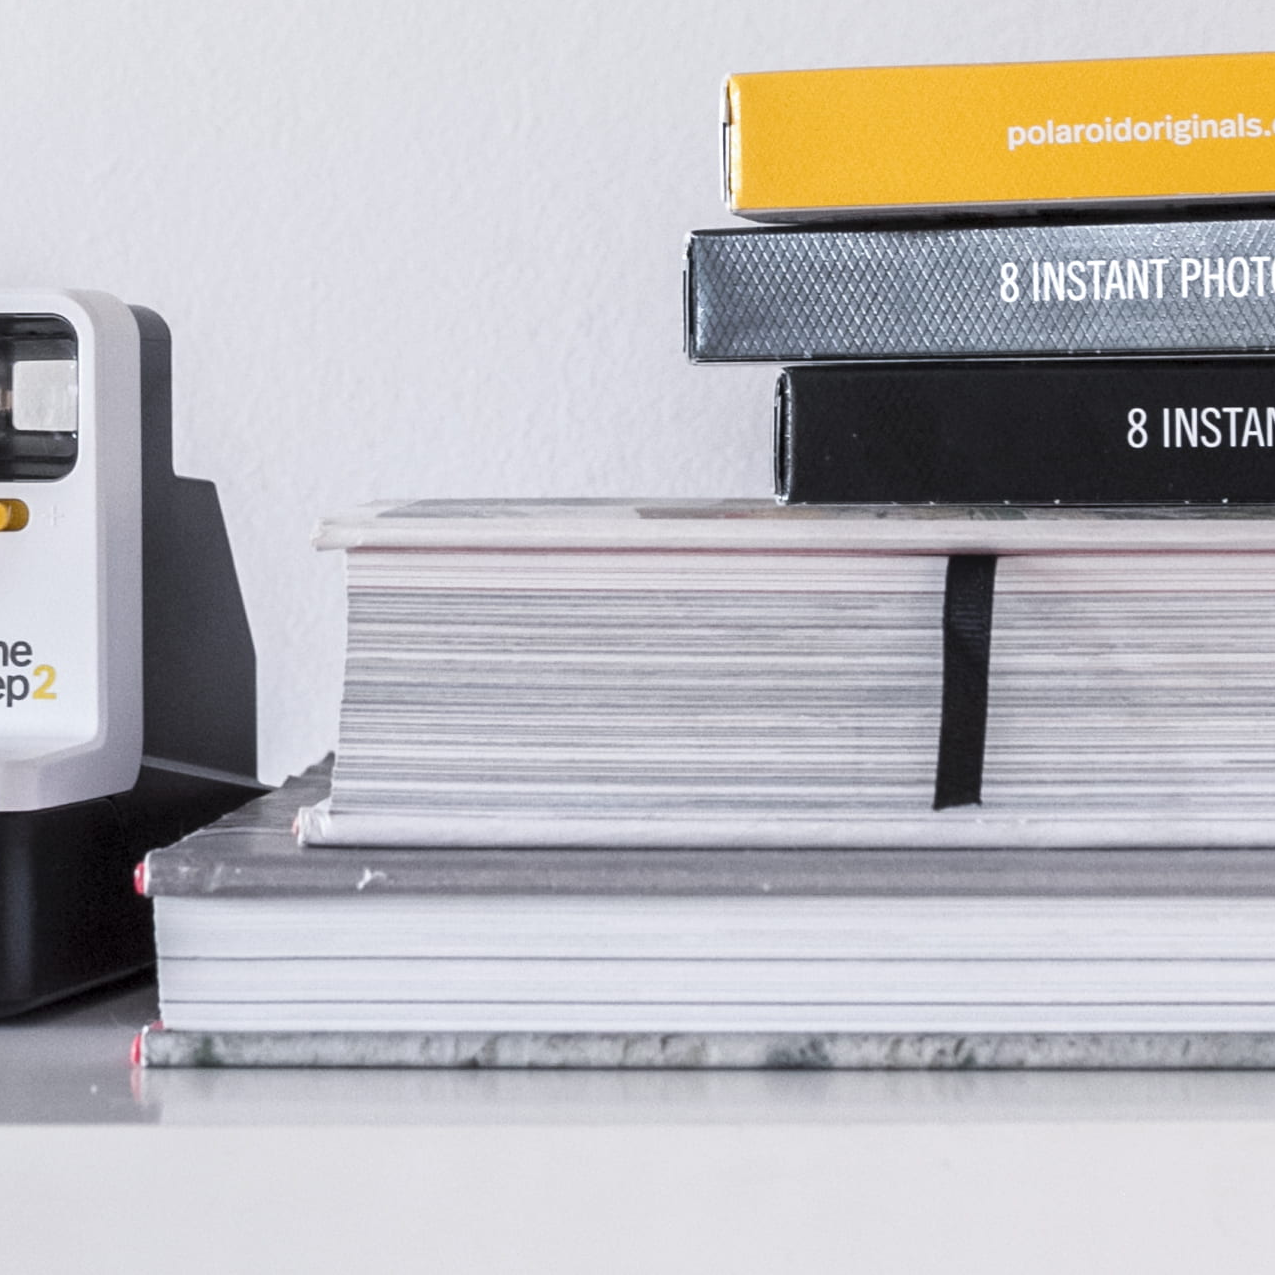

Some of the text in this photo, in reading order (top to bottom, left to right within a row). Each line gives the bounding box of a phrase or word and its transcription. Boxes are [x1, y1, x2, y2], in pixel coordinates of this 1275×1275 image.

[1000, 261, 1020, 303] 8
[1032, 258, 1169, 302] INSTANT
[1127, 407, 1148, 449] 8
